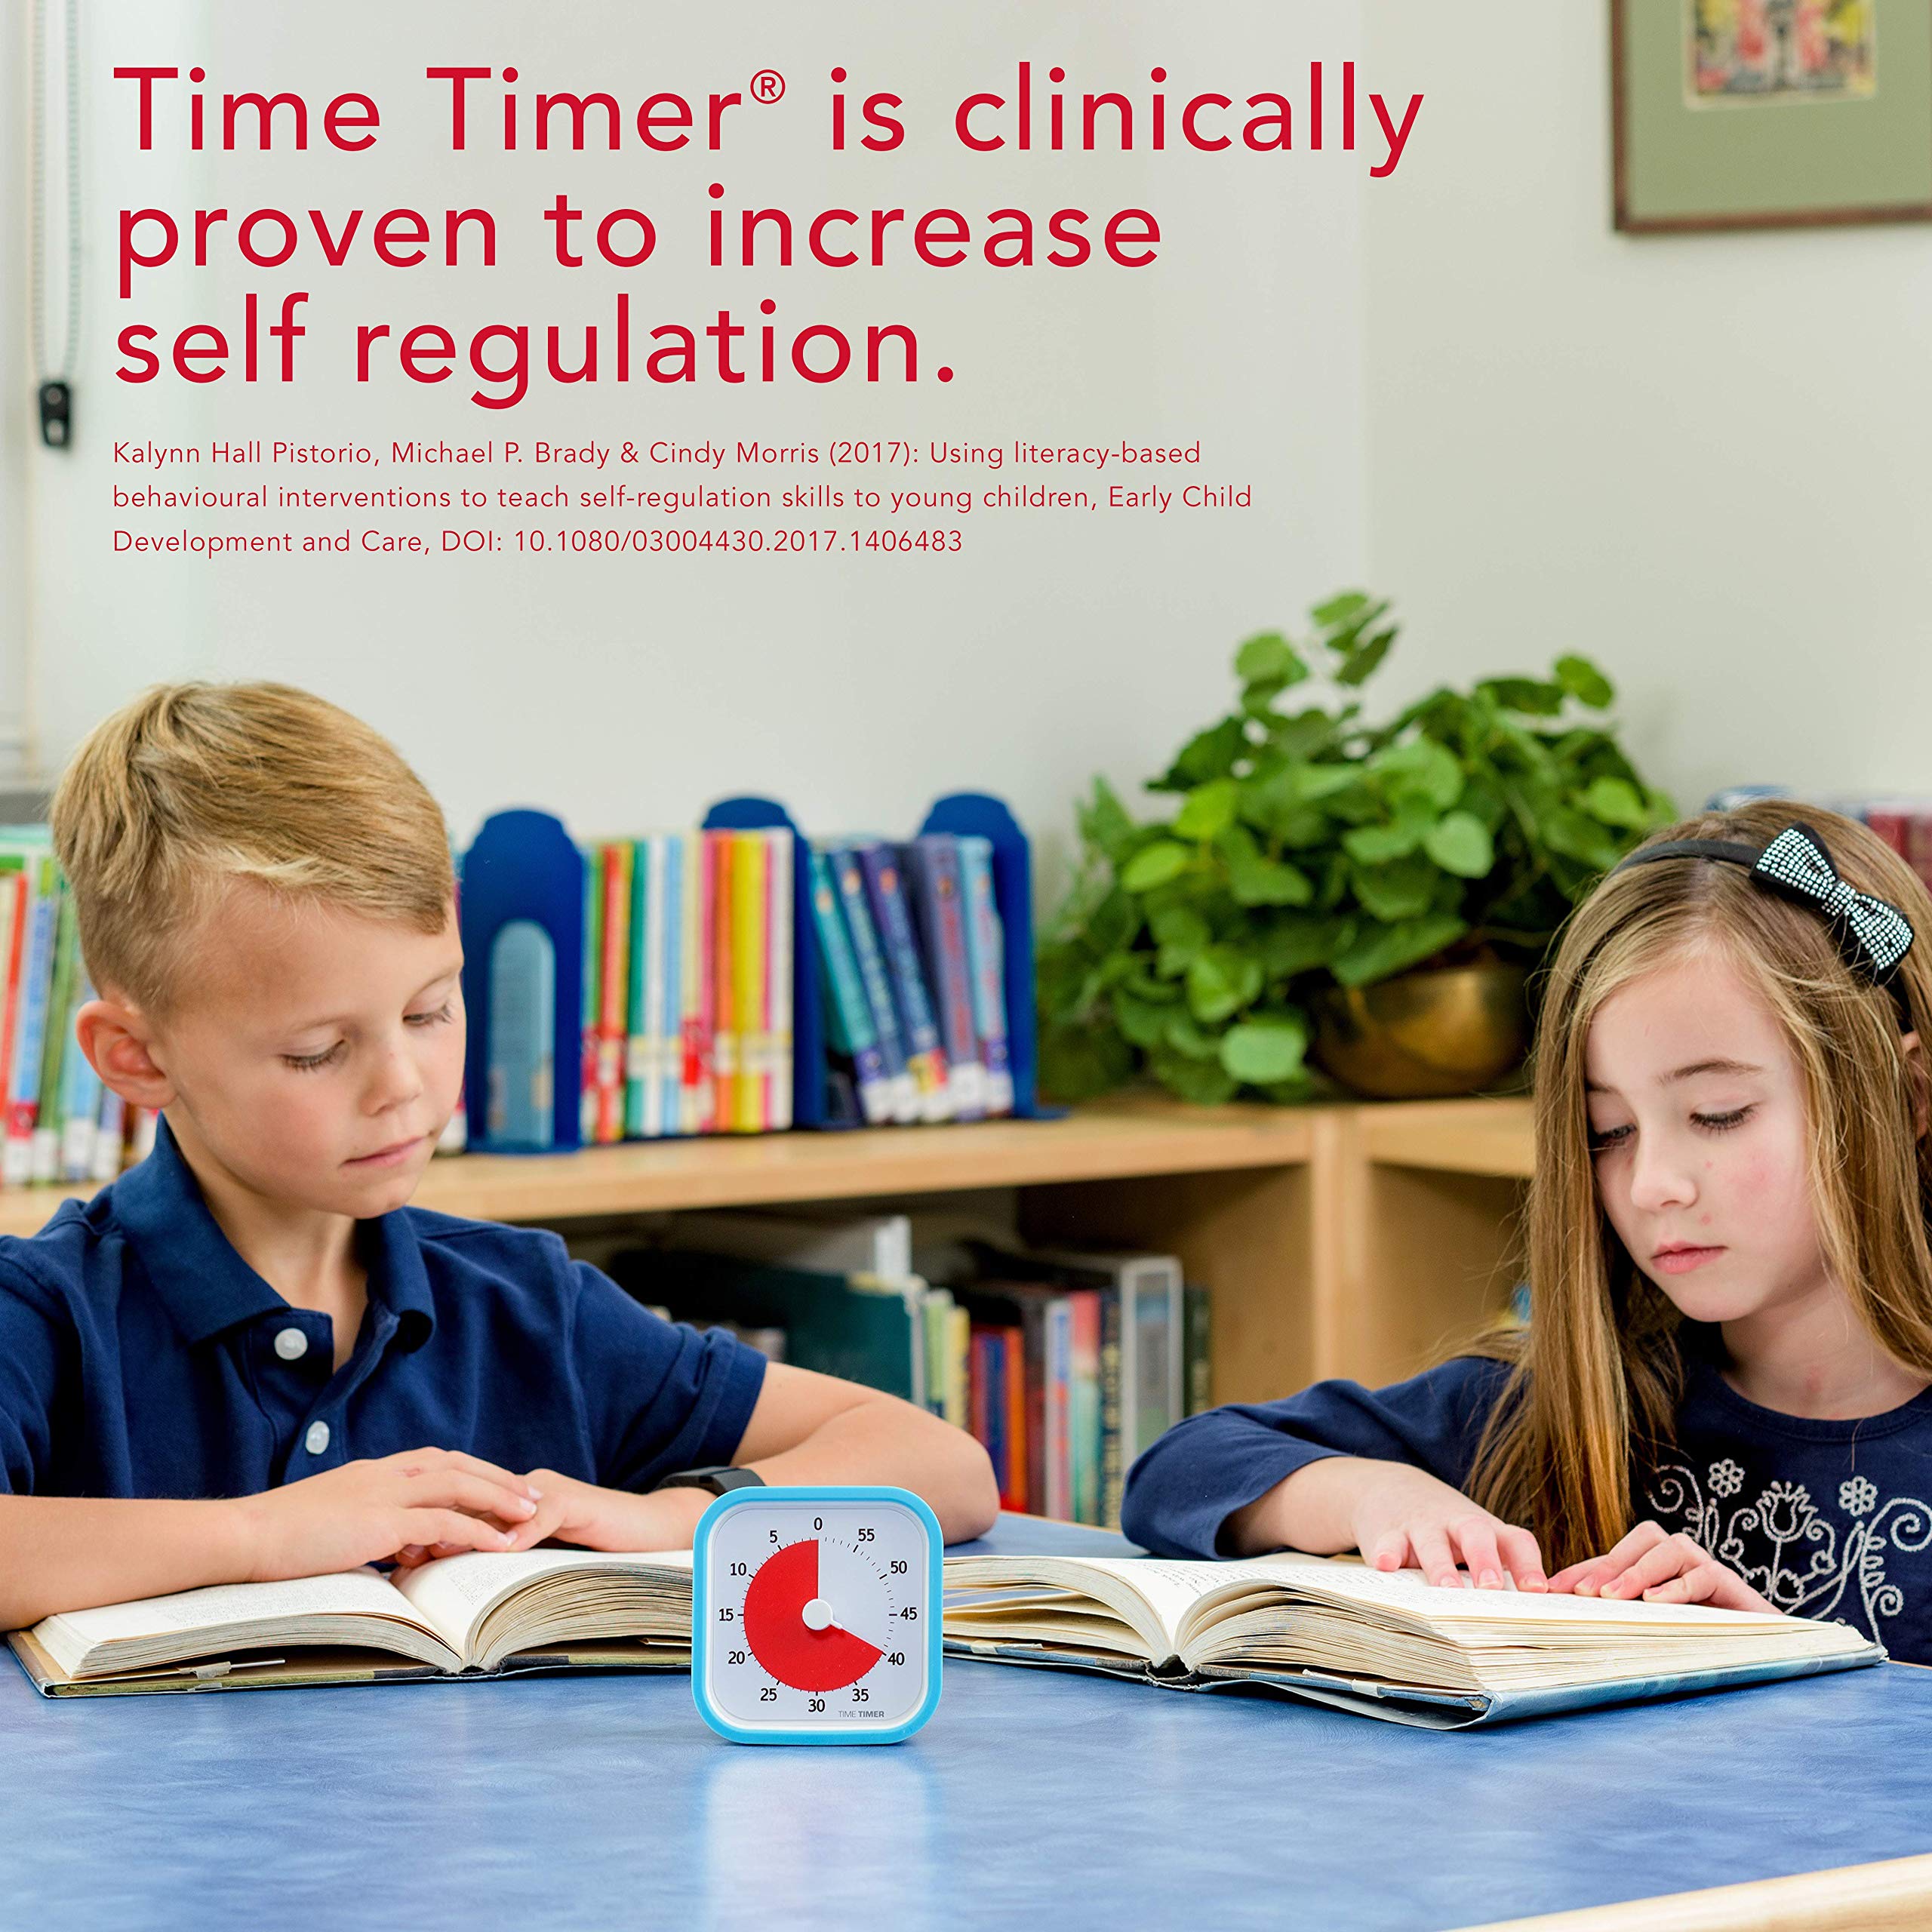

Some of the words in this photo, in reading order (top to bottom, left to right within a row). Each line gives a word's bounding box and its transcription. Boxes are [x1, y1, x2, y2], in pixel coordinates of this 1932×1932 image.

[814, 1517, 823, 1531] 0
[769, 1531, 778, 1543] 5
[858, 1528, 875, 1541] 55
[730, 1563, 746, 1576] 10
[891, 1561, 907, 1574] 50
[718, 1608, 734, 1621] 15
[900, 1607, 917, 1620] 45
[728, 1651, 745, 1664] 20
[888, 1652, 905, 1666] 40
[760, 1688, 777, 1701] 25
[852, 1688, 869, 1702] 35
[808, 1699, 825, 1712] 30
[838, 1710, 856, 1718] TIME
[858, 1710, 884, 1718] TIMER
